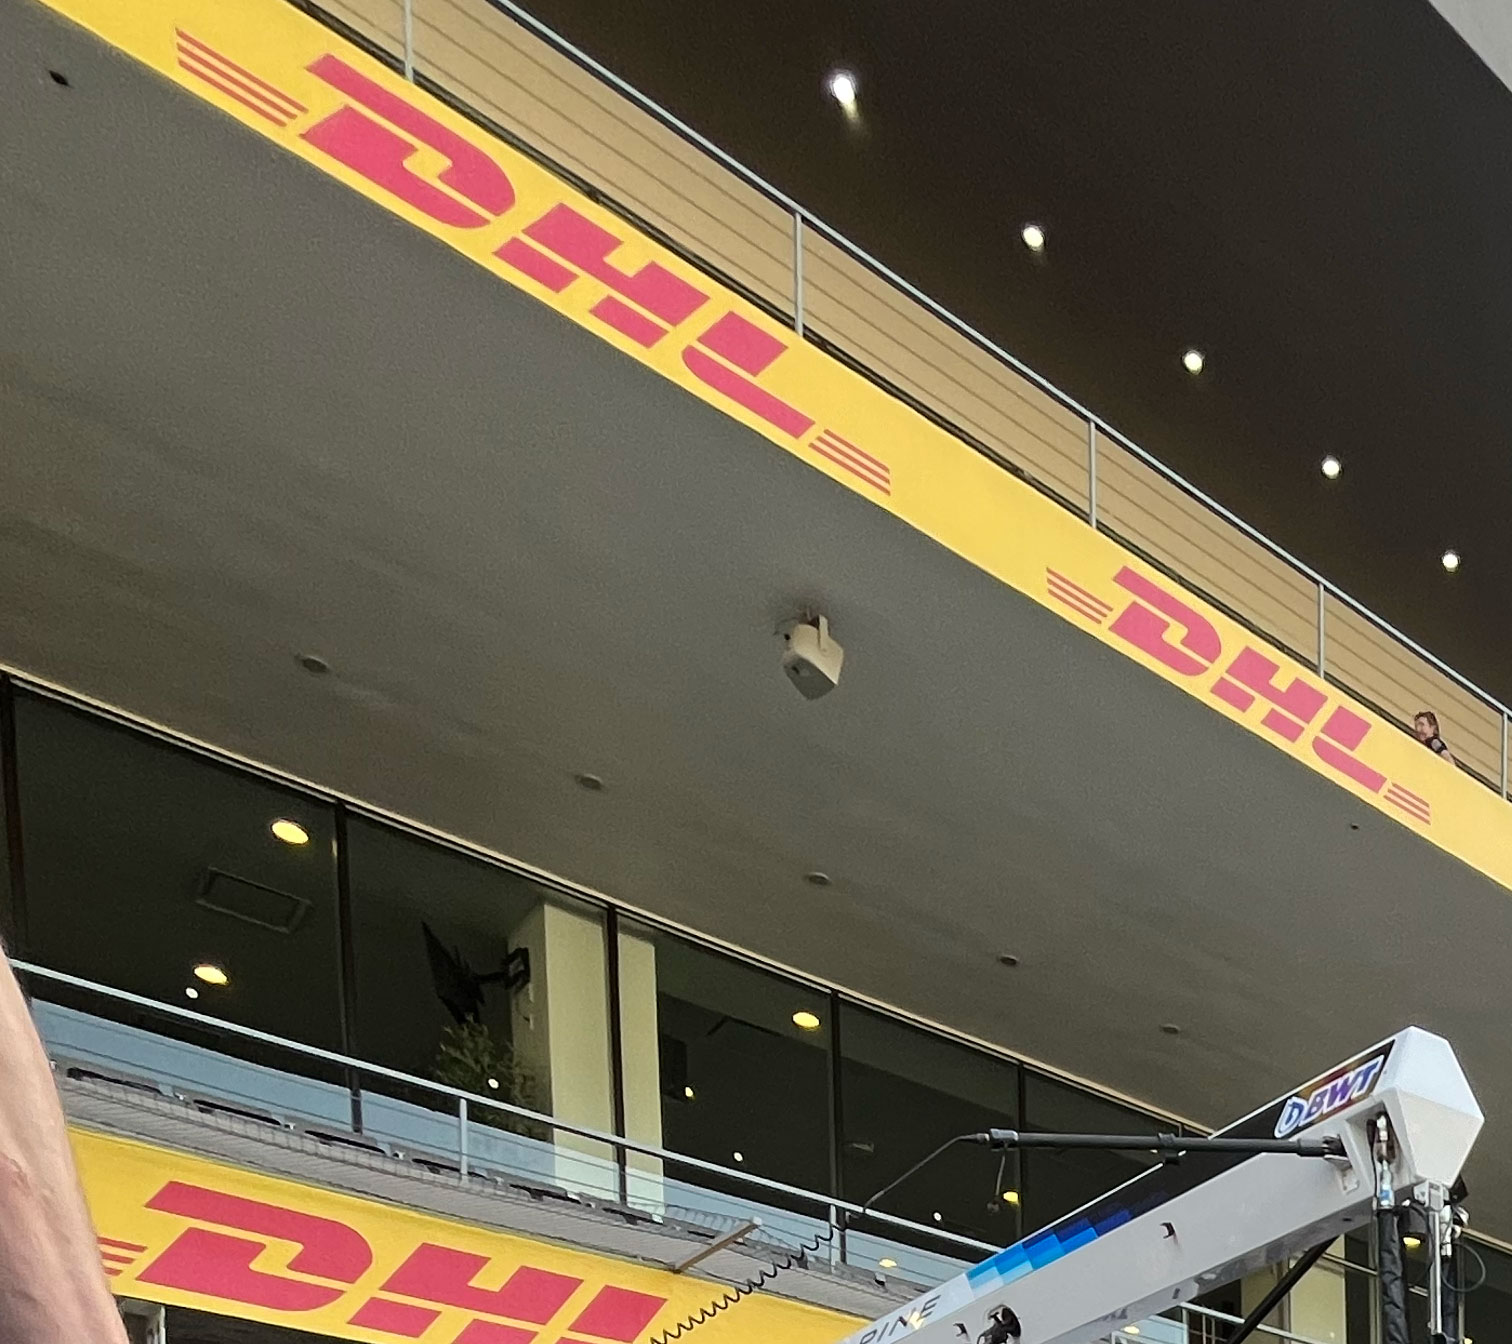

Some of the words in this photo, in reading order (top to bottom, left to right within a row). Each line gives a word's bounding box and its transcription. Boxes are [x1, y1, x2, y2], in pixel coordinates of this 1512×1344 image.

[300, 53, 816, 441] DHL
[1108, 565, 1387, 795] DHL
[1300, 1055, 1384, 1126] BWT
